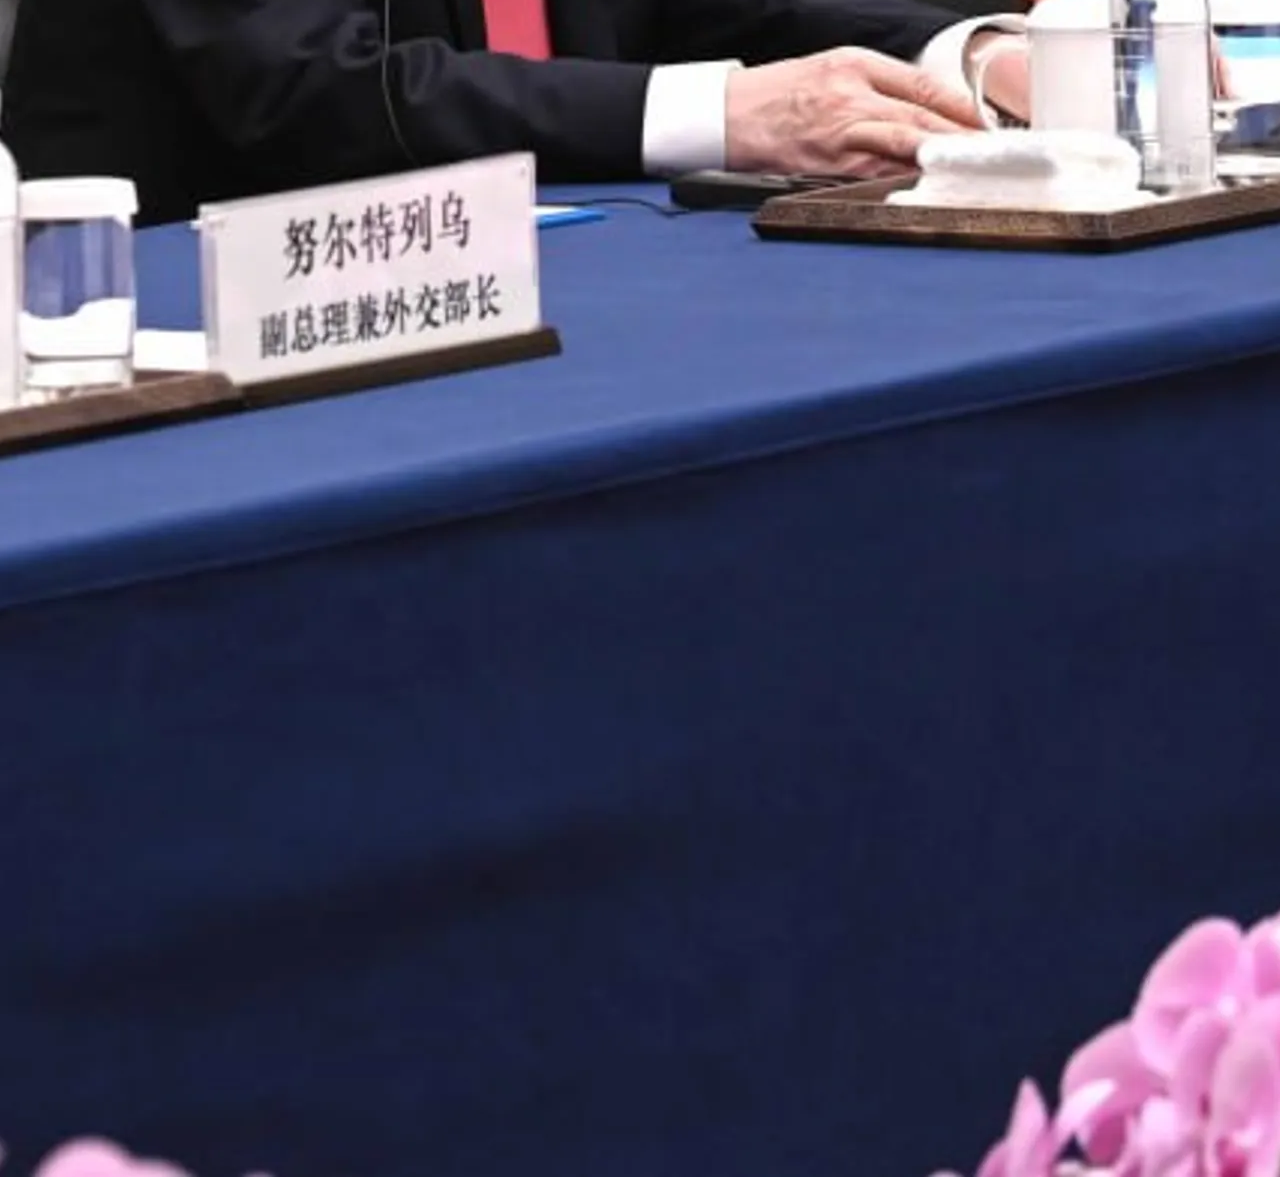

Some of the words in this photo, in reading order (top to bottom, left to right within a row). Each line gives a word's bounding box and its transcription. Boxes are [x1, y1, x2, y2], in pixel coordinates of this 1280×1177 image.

[283, 191, 471, 279] 努尔特列乌
[260, 274, 502, 360] 副总理兼外交部长
